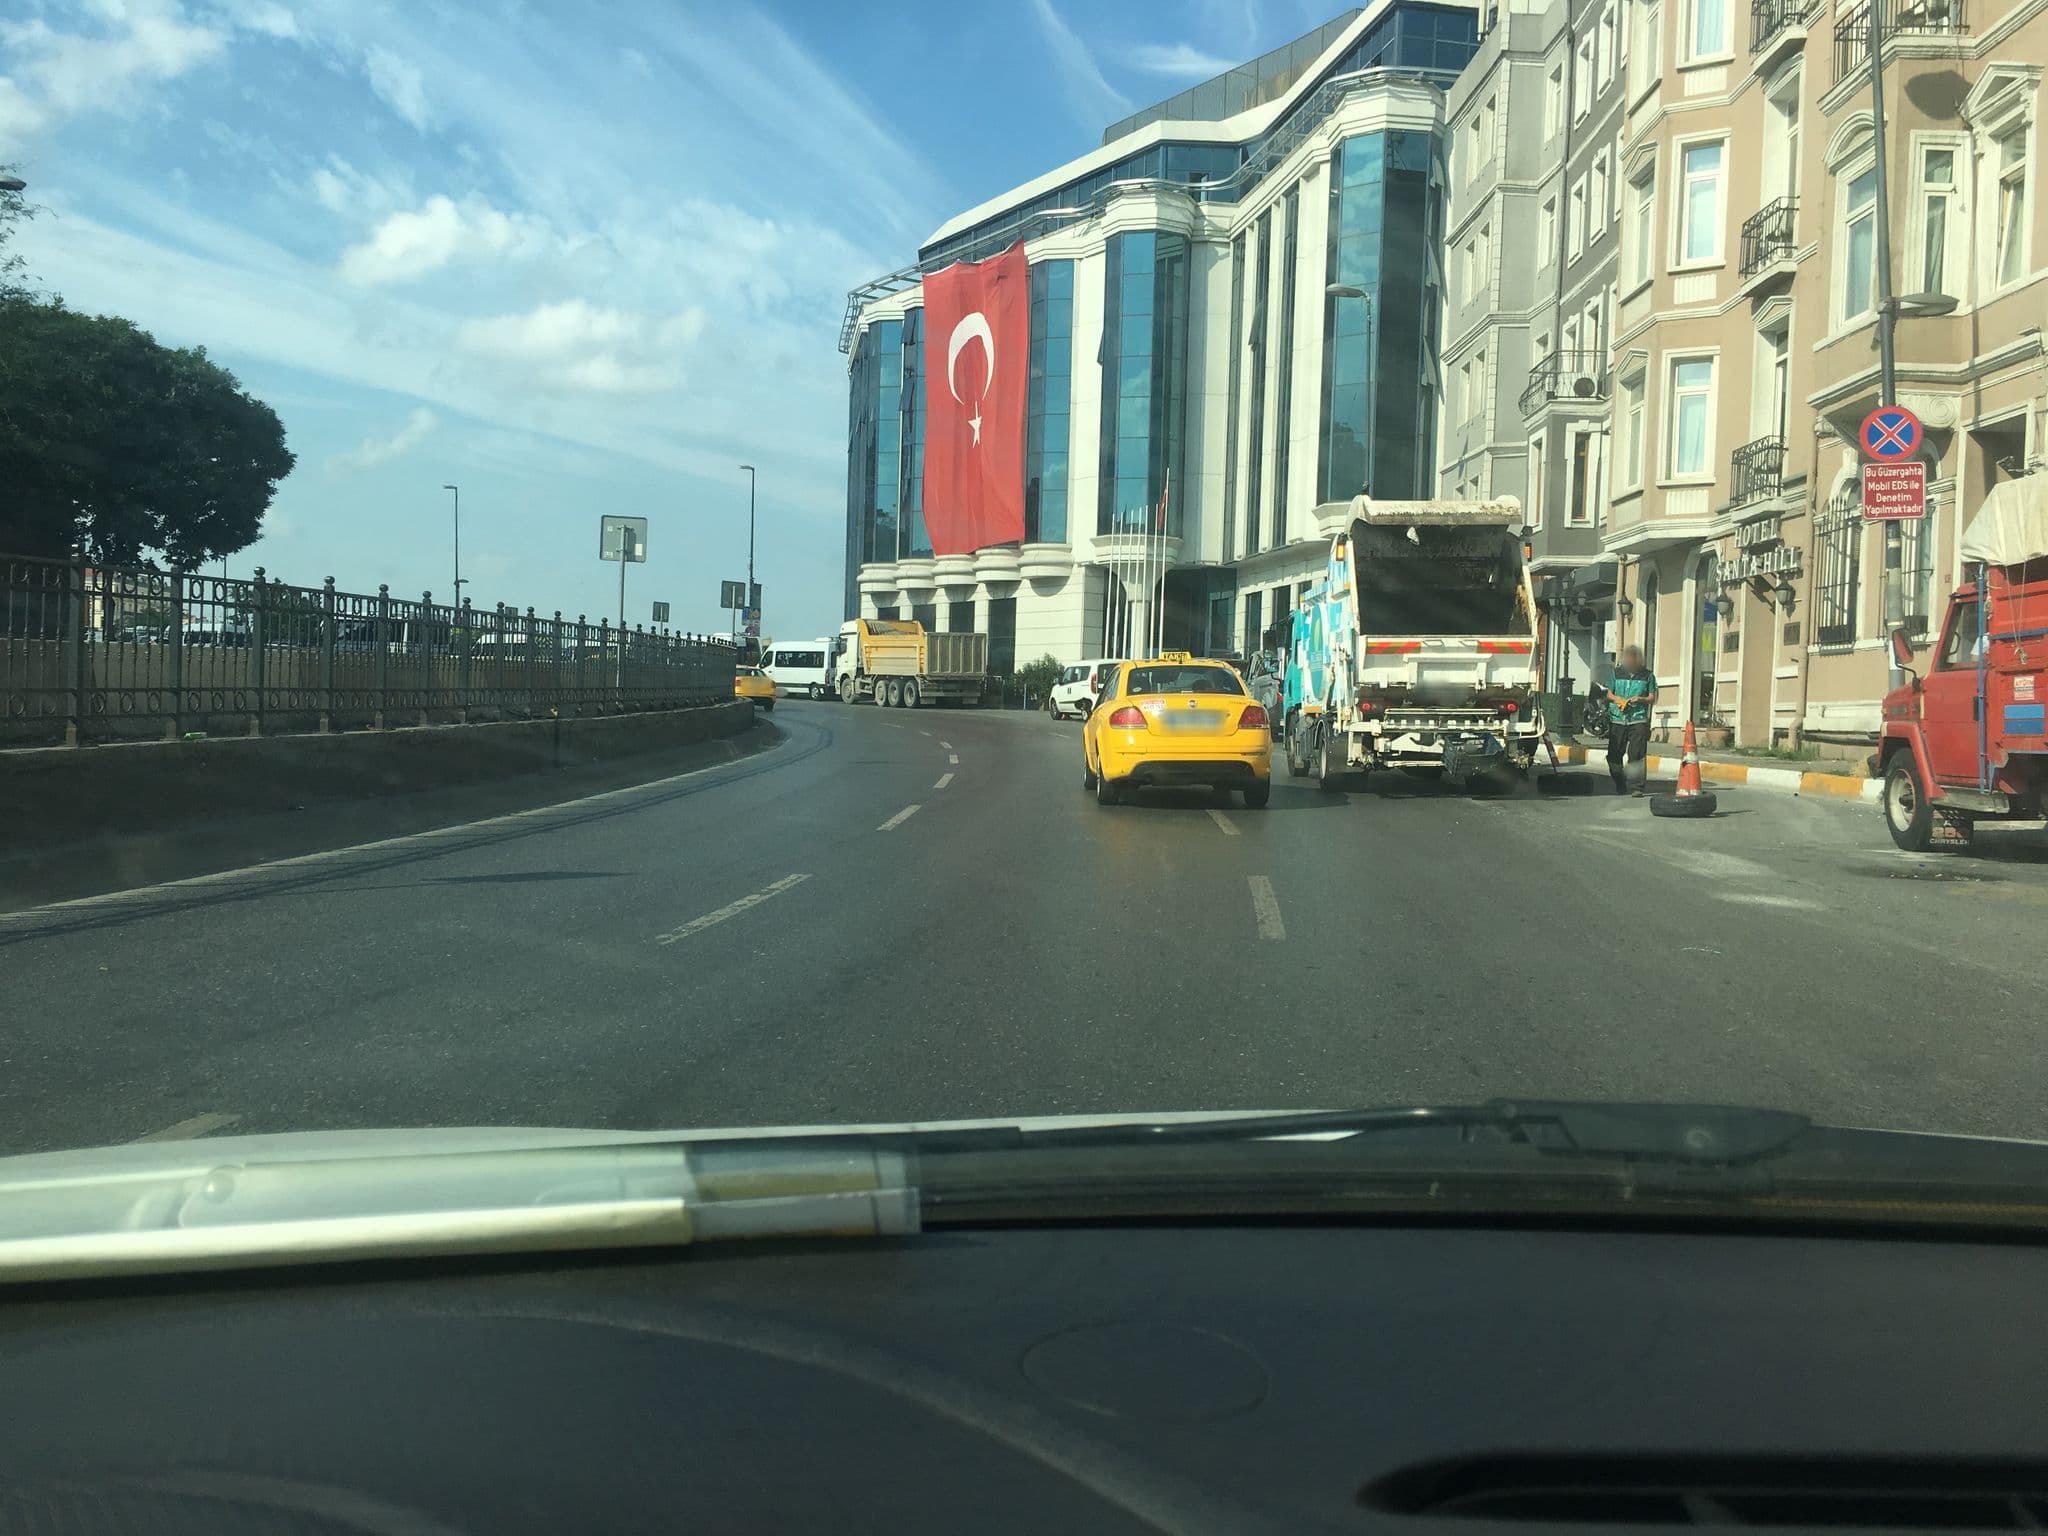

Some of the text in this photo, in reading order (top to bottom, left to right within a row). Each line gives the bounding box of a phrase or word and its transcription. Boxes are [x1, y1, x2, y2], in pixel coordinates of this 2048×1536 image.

[1865, 466, 1922, 478] Bu Güzergahta
[1868, 480, 1920, 491] Mobil EDS ile
[1876, 493, 1912, 502] Denetim
[1865, 504, 1922, 516] Yapılmaktadır
[1734, 518, 1777, 548] HOTEL
[1716, 554, 1758, 582] SANTA
